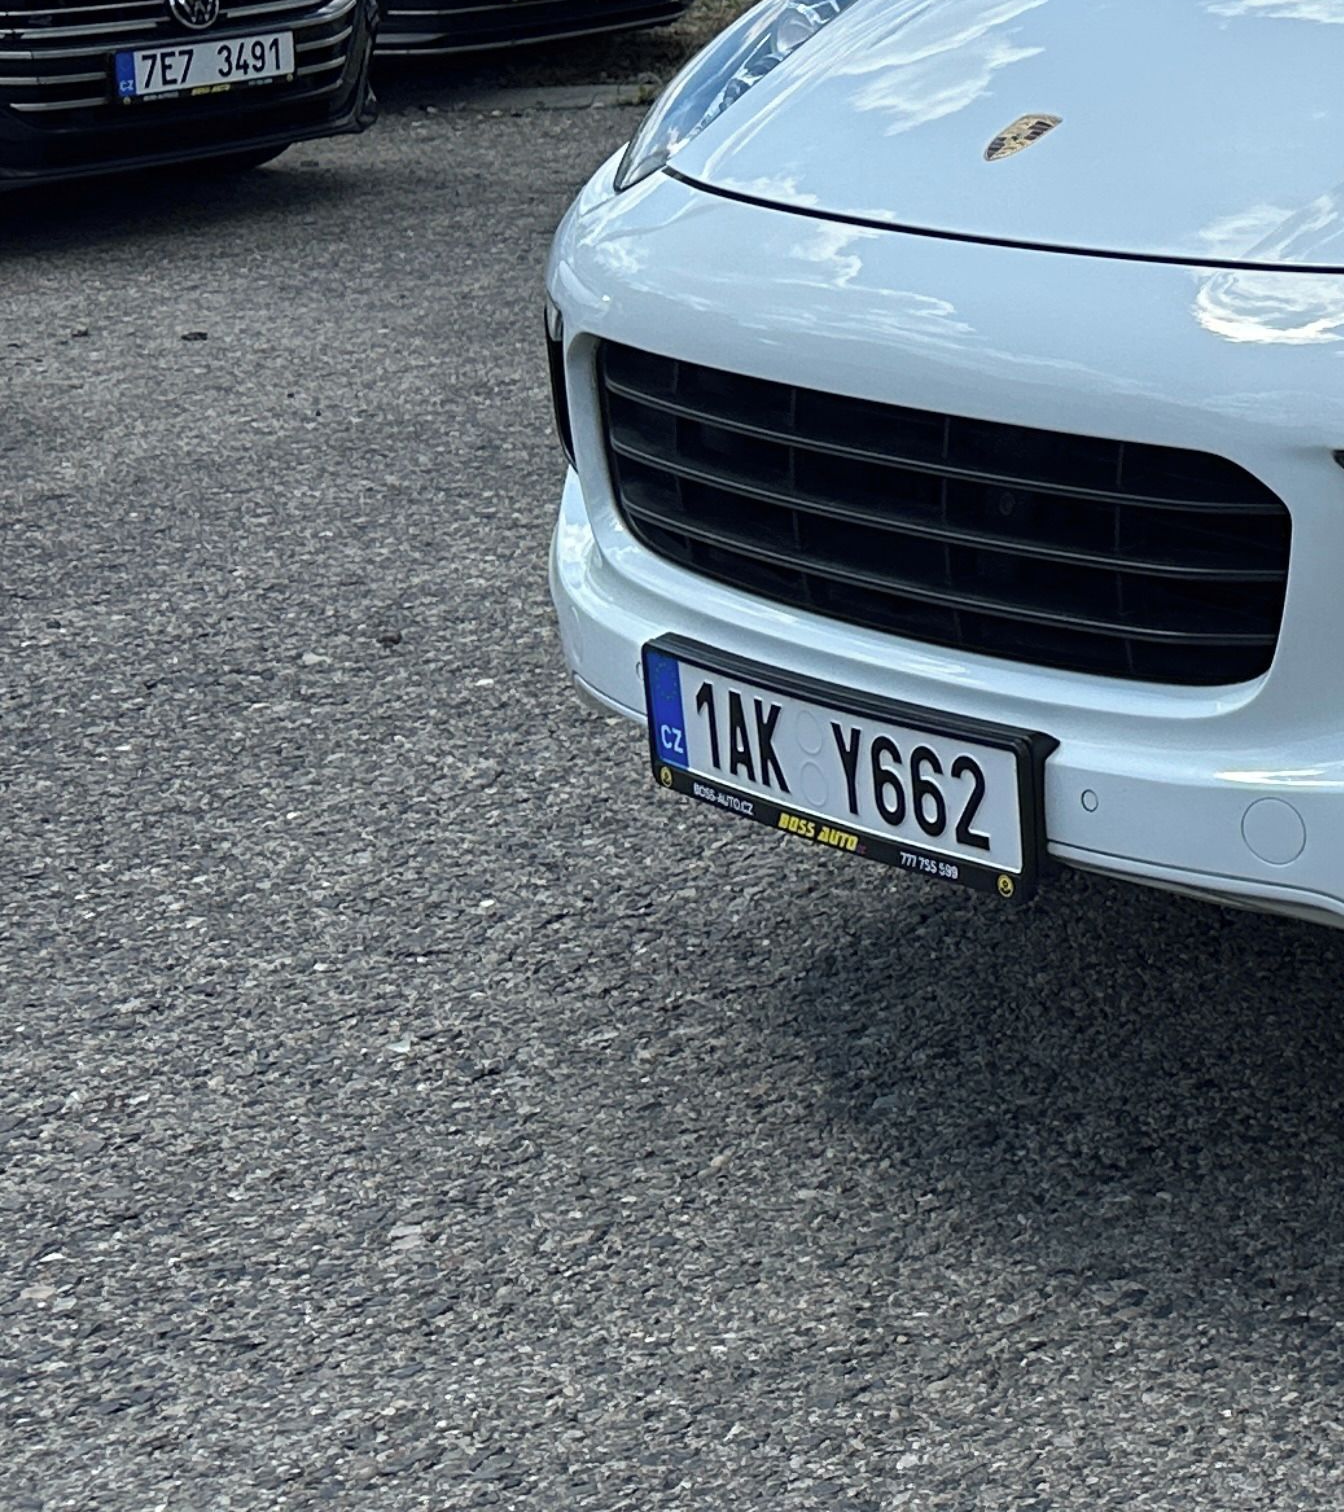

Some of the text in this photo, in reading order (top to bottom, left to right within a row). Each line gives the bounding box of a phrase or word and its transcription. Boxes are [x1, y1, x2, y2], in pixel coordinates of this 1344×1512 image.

[141, 38, 281, 88] 7E7 3491
[660, 723, 684, 754] CZ
[696, 681, 990, 851] 1AK Y662
[693, 782, 754, 816] BOSS-AUTO.CZ
[778, 812, 816, 838] BOSS
[817, 826, 859, 852] AUTO
[901, 852, 917, 869] 777
